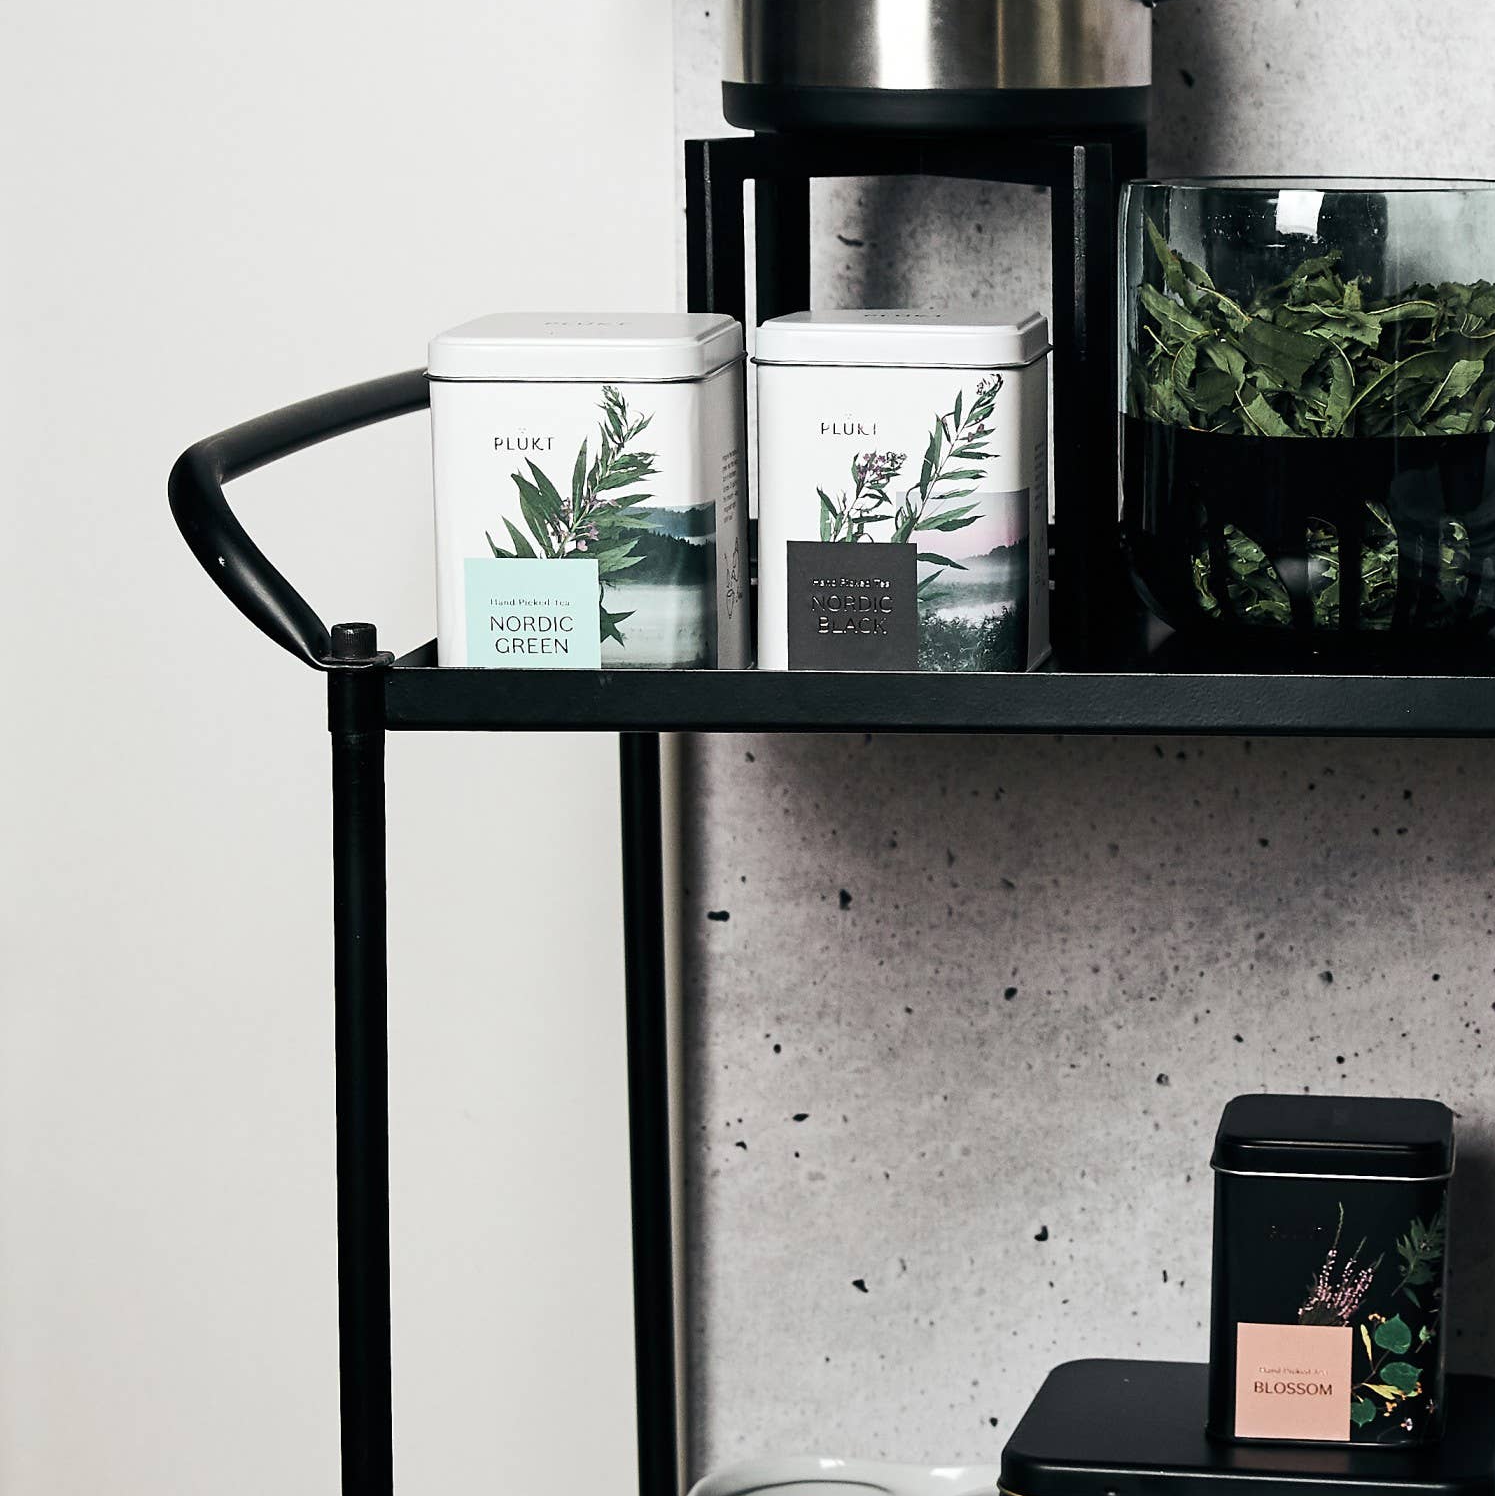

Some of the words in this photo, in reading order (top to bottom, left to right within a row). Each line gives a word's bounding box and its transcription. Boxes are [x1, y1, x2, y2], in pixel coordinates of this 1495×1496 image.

[811, 595, 893, 613] NORDIC
[490, 615, 574, 632] NORDIC
[818, 616, 888, 634] BLACK
[495, 637, 569, 654] GREEN
[1254, 1381, 1333, 1395] BLOSSOM
